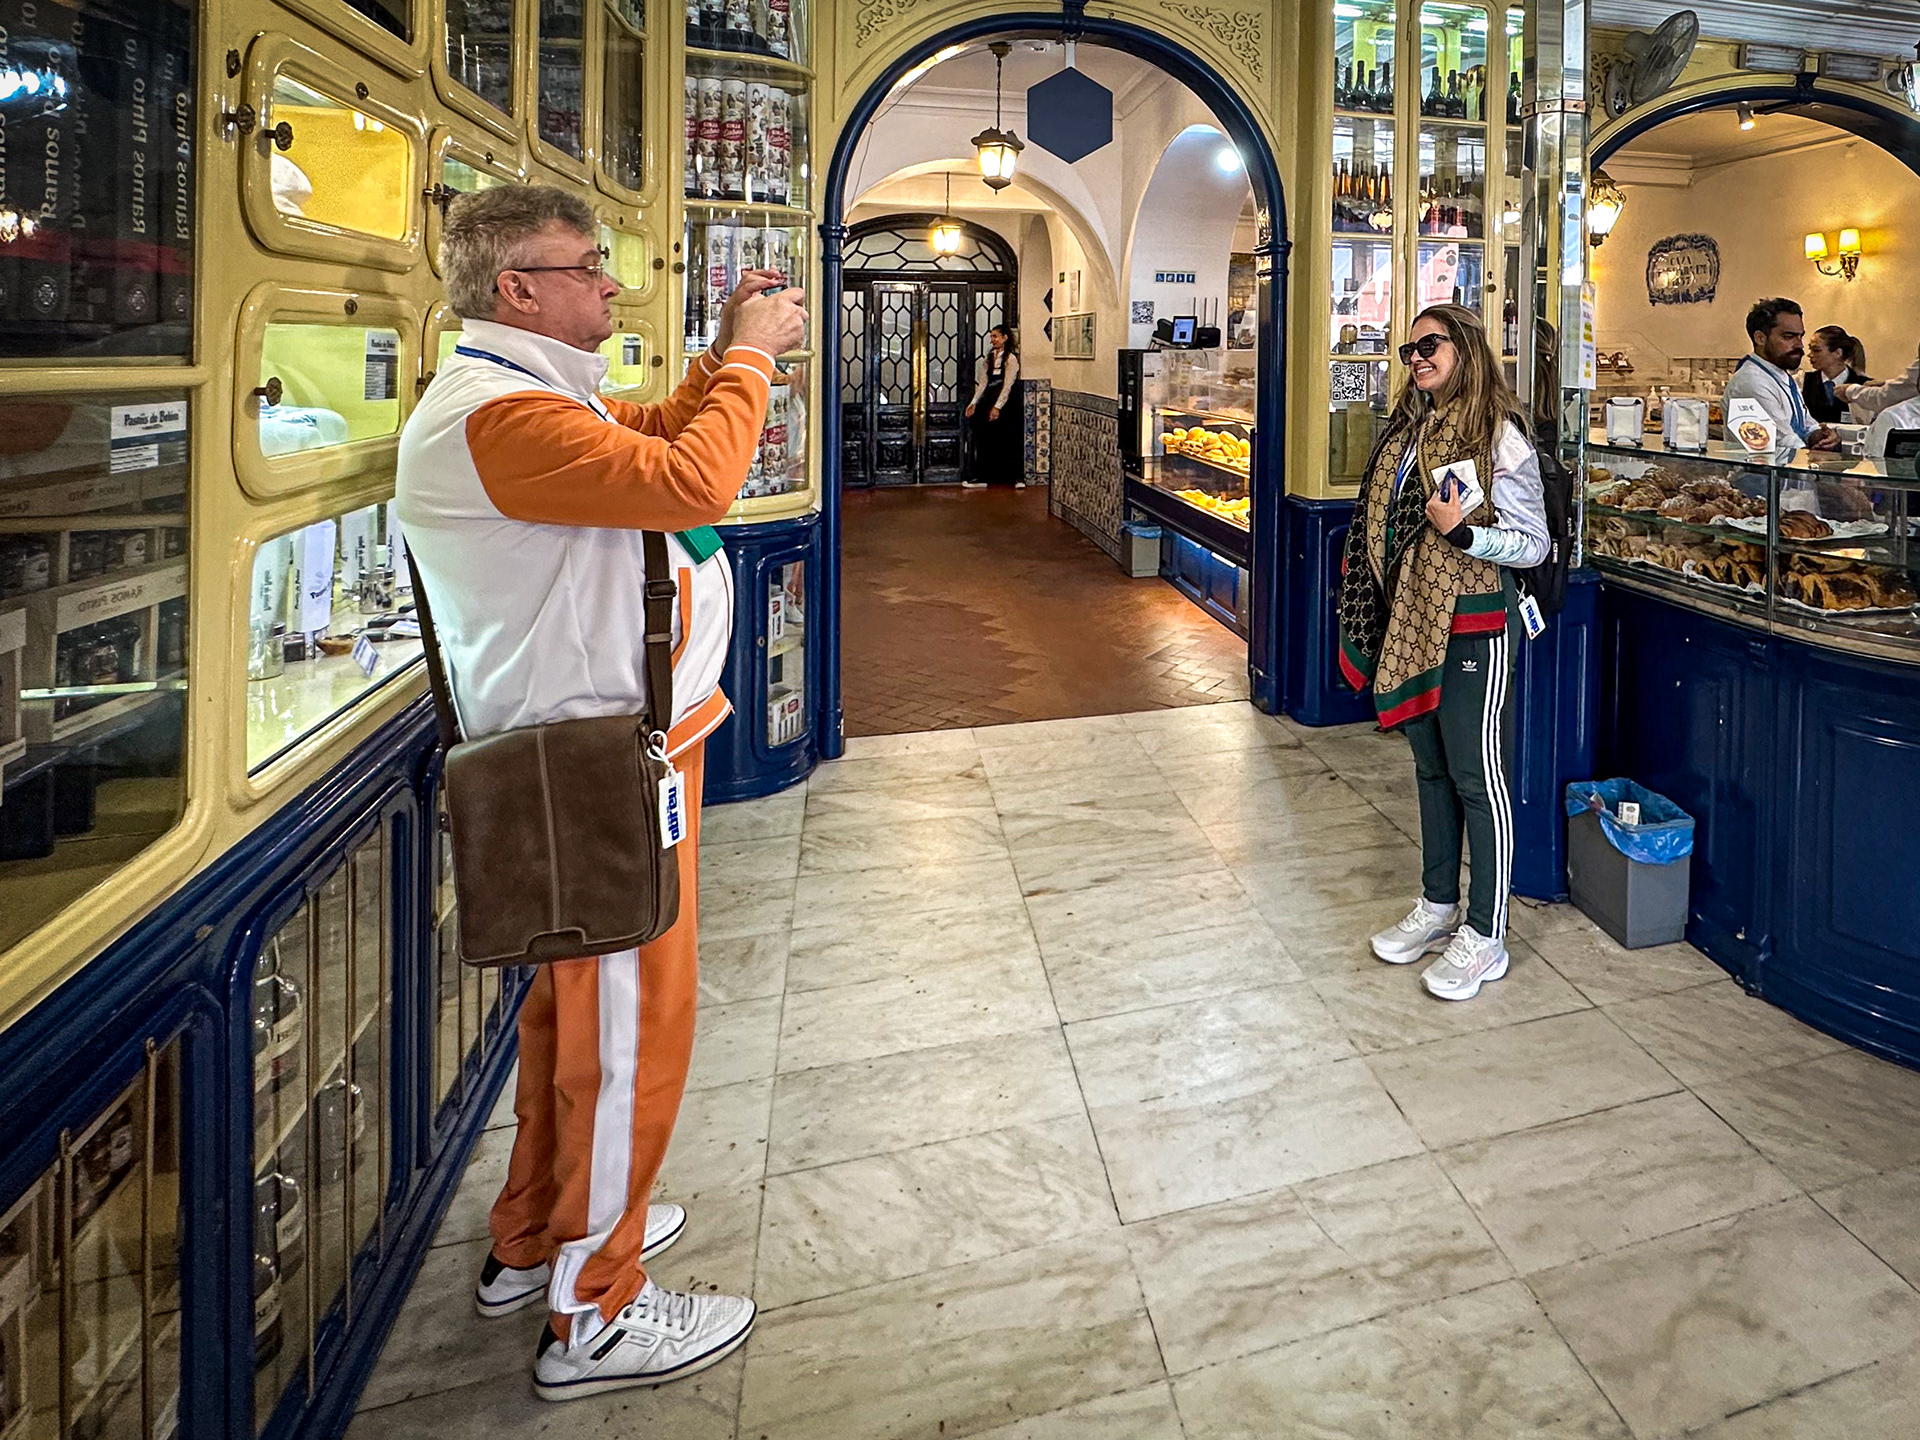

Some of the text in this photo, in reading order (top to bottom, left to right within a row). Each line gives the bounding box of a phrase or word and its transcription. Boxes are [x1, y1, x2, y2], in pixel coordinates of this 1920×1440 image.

[39, 46, 61, 220] Ramos Pto
[1526, 604, 1540, 633] abreu
[667, 786, 679, 841] abreu
